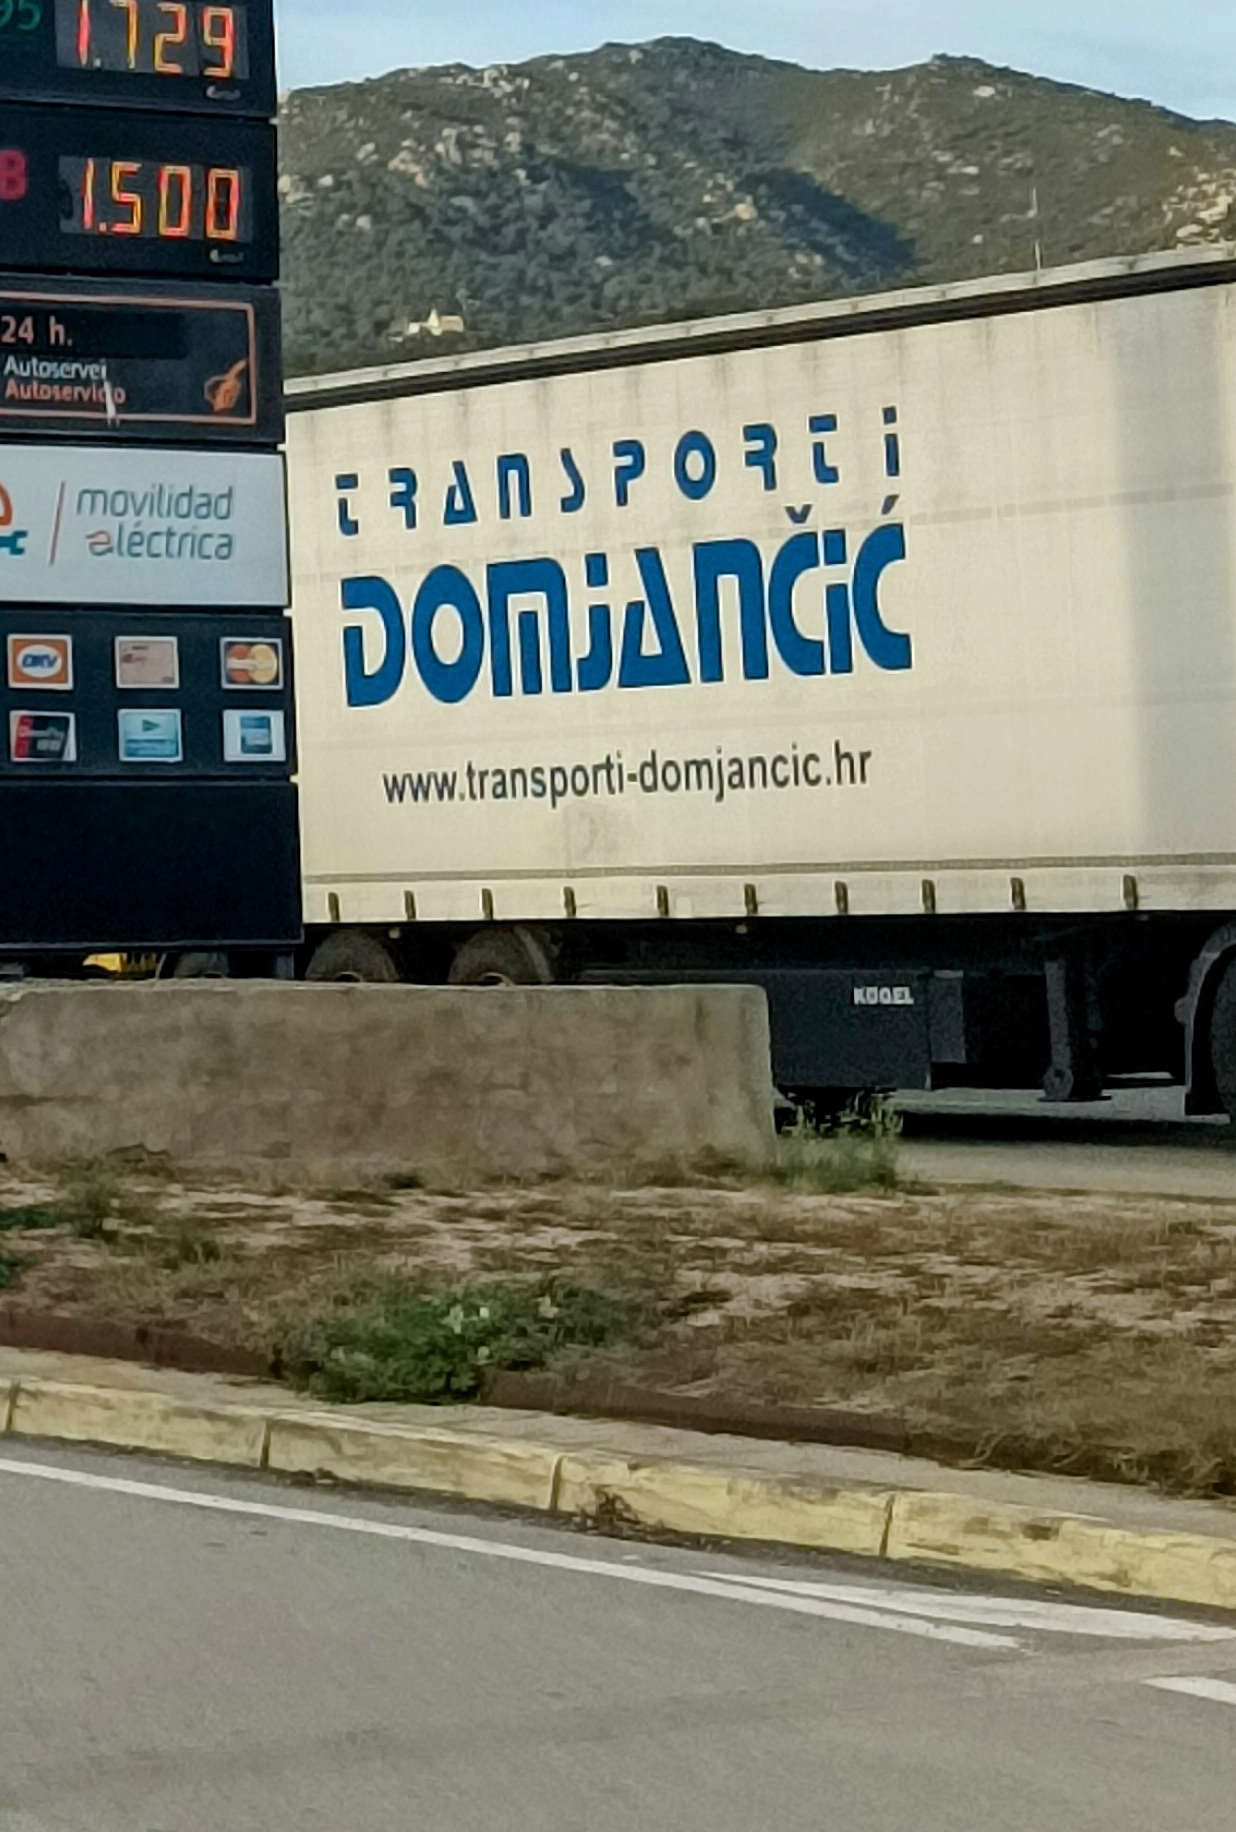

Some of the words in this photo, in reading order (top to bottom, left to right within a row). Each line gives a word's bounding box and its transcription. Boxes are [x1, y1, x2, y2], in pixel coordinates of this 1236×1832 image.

[82, 158, 241, 241] 1.500
[0, 315, 34, 345] 24
[48, 315, 74, 346] h.
[5, 377, 127, 404] Autoservico
[76, 484, 234, 521] movilidad
[86, 520, 234, 560] eléctrica
[383, 740, 872, 808] www.transporti-domjancic.hr
